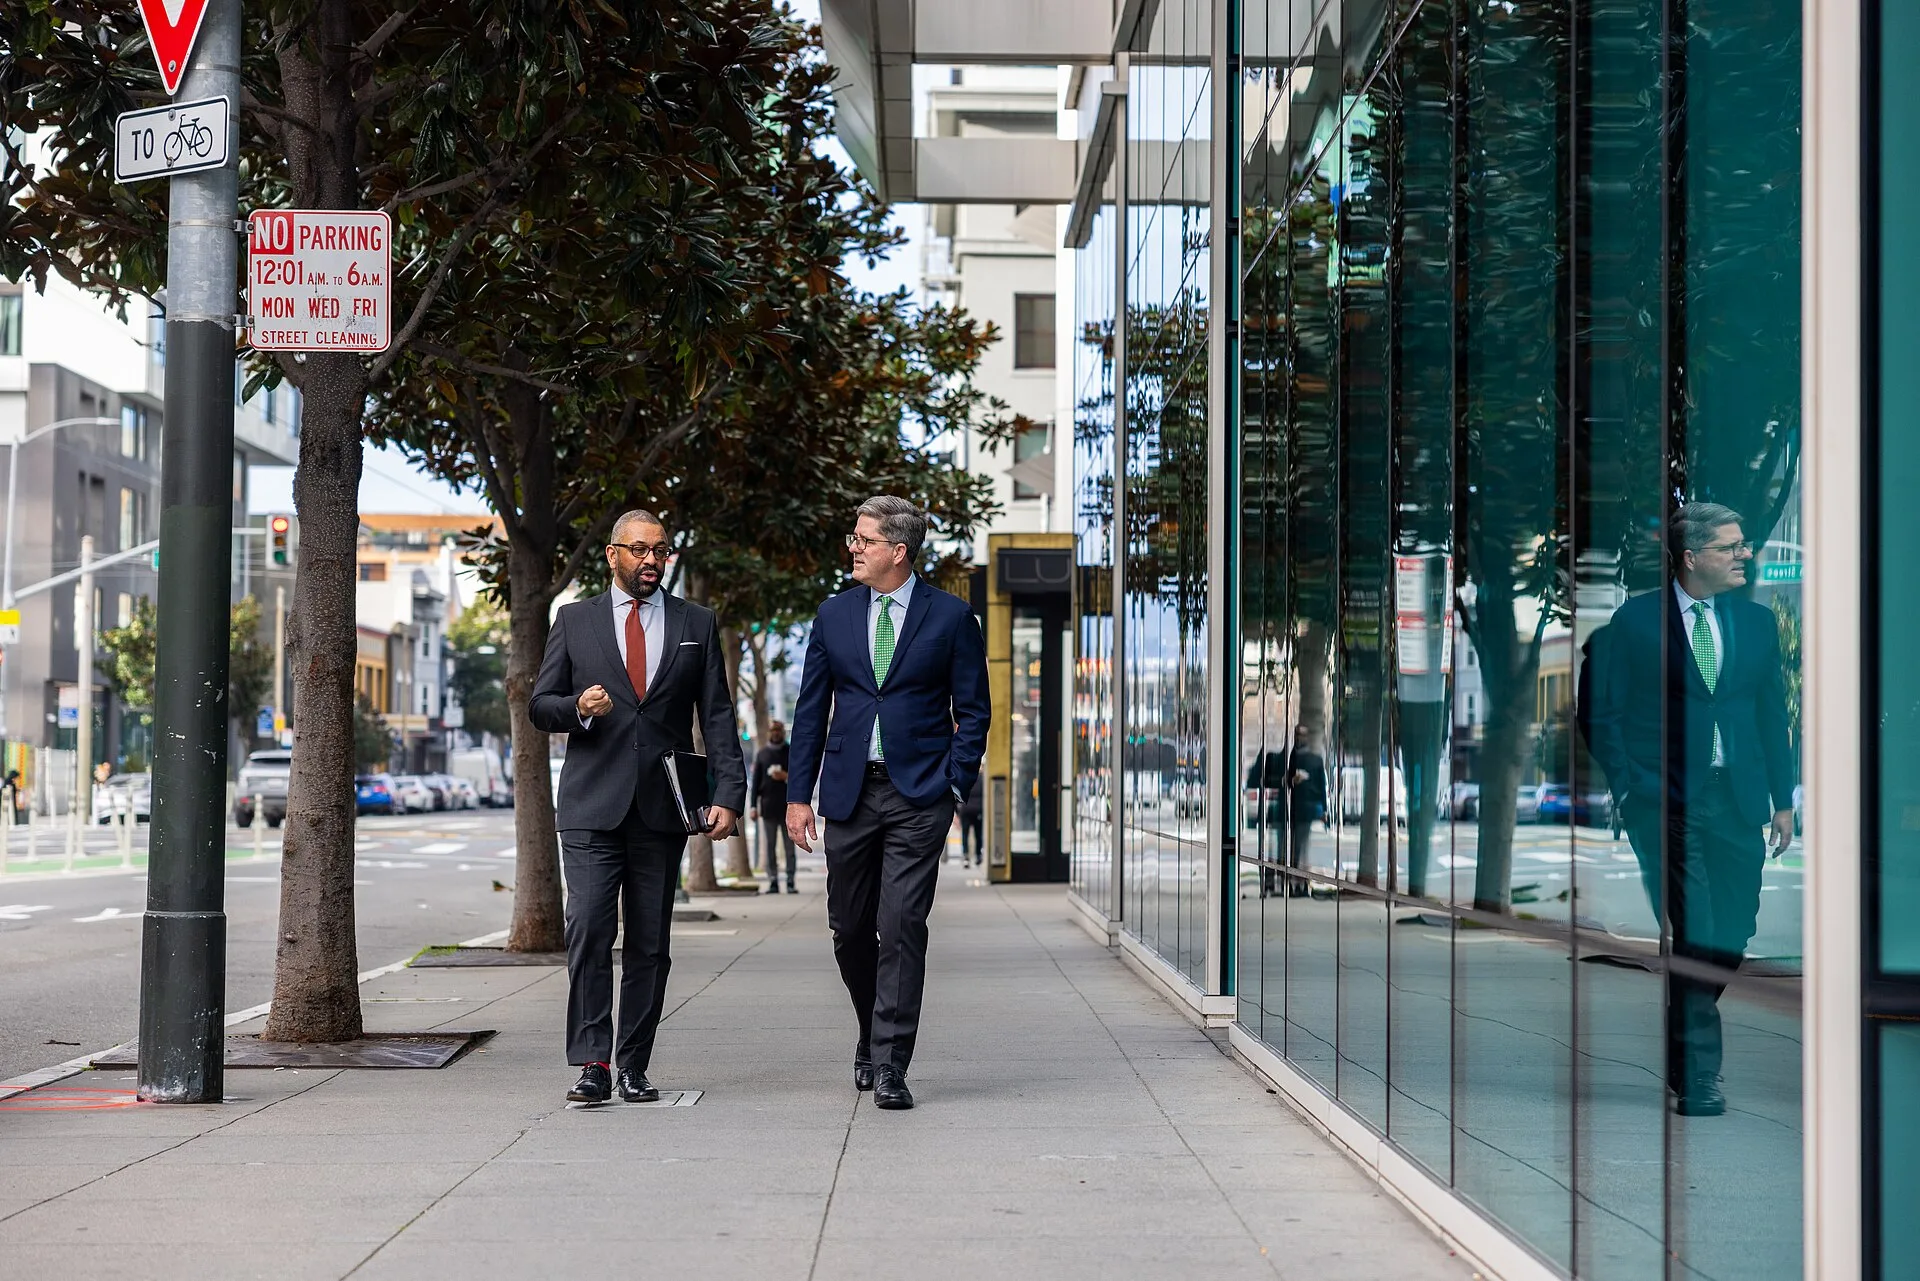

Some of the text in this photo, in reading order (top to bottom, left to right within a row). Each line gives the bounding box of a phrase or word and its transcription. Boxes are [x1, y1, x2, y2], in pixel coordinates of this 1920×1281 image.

[131, 127, 155, 161] TO
[255, 215, 382, 251] NO PARKING
[256, 259, 383, 286] 12:01 A.M. TO 6 A.M.
[262, 296, 377, 319] MON WED FRI
[261, 330, 377, 345] STREET CLEANING
